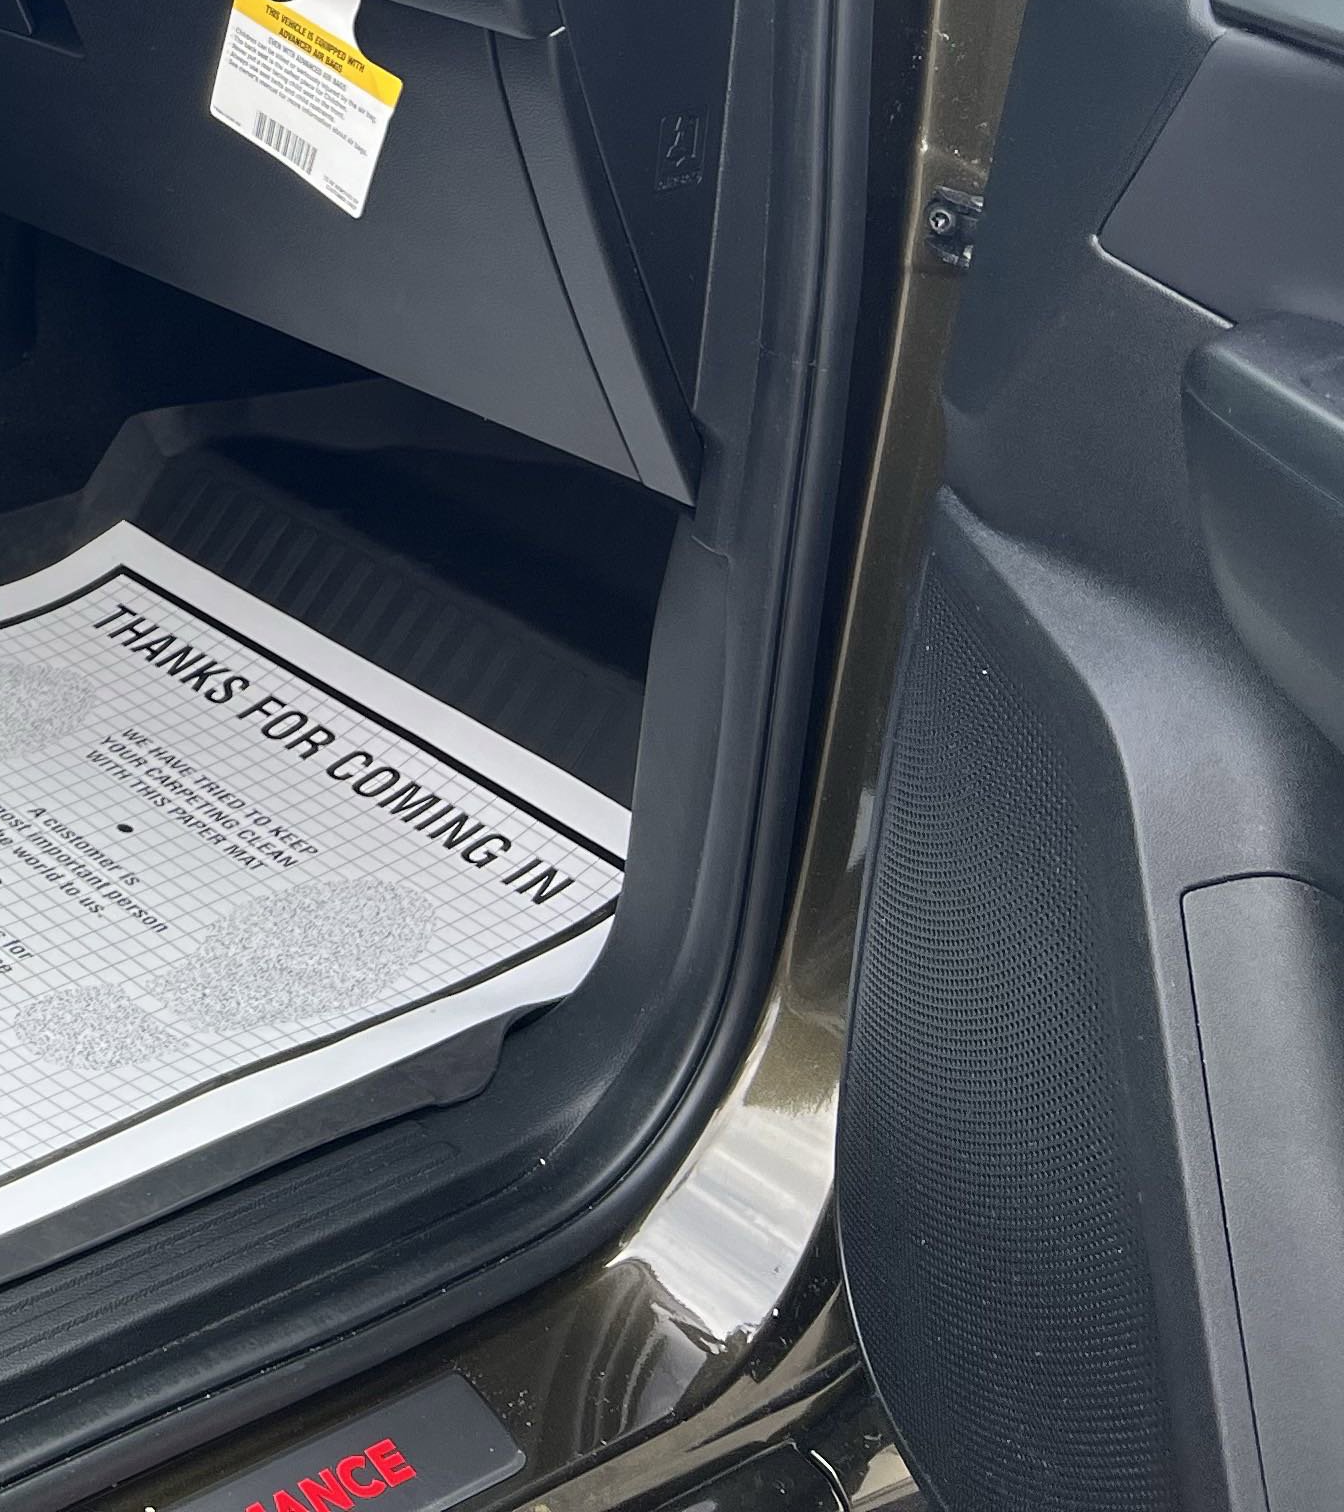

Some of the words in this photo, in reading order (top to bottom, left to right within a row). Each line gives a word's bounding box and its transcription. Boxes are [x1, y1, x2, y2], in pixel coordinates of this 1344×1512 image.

[265, 5, 280, 20] THIS
[281, 15, 307, 37] VEHICLE
[306, 30, 314, 42] IS
[314, 35, 347, 62] EQUIPPED
[346, 55, 366, 73] WITH
[92, 603, 250, 704] THANKS
[238, 695, 336, 761] FOR
[326, 750, 512, 870] COMING
[502, 857, 575, 905] IN
[101, 736, 148, 768] YOUR
[145, 767, 240, 830] CARPETING
[237, 829, 299, 868] CLEAN
[122, 728, 154, 747] WE
[149, 747, 197, 777] HAVE
[194, 775, 246, 810] TRIED
[245, 808, 272, 827] TO
[269, 826, 318, 855] KEEP
[27, 806, 47, 819] A
[43, 818, 122, 872] customer
[119, 871, 141, 887] is
[86, 749, 133, 780] WITH
[130, 778, 172, 807] THIS
[168, 806, 227, 846] PAPER
[224, 844, 269, 871] MAT
[13, 845, 64, 883] world
[60, 881, 81, 897] to
[79, 896, 105, 918] us.
[28, 831, 110, 890] important
[102, 890, 169, 933] person
[3, 938, 35, 960] for
